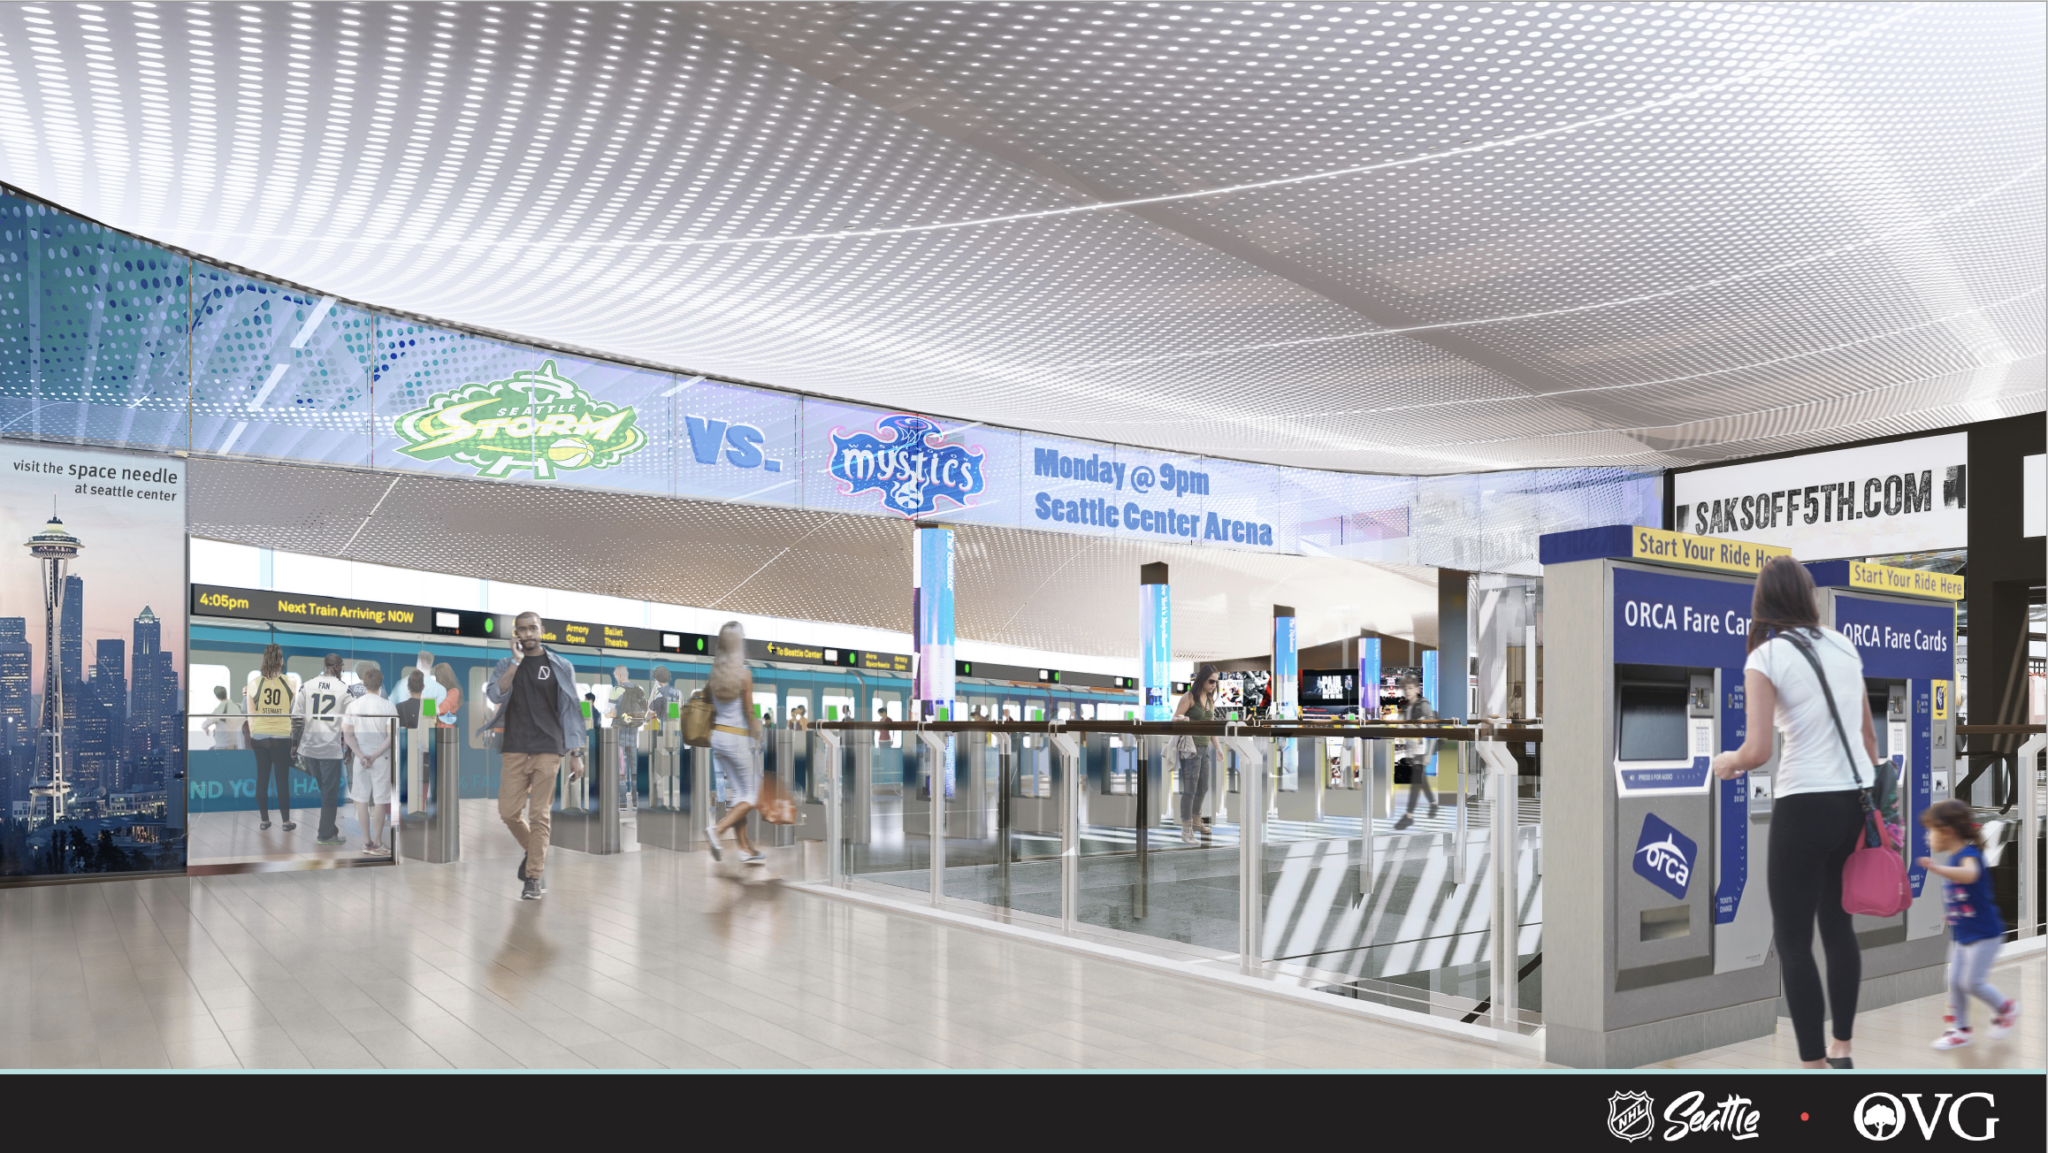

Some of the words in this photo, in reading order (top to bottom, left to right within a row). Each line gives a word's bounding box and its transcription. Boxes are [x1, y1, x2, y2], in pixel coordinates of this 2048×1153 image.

[408, 398, 642, 452] STORM
[496, 403, 577, 417] SEATTLE
[684, 415, 784, 473] VS.
[14, 460, 40, 473] visit
[43, 461, 64, 475] the
[68, 463, 117, 480] space
[122, 467, 178, 484] needle
[1034, 447, 1126, 491] Monday
[1130, 465, 1155, 493] @
[1159, 462, 1210, 498] 9pm
[75, 483, 87, 494] at
[90, 484, 134, 498] seattle
[137, 489, 177, 501] center
[1695, 470, 1932, 535] SAKSOFF5TH.COM
[1034, 492, 1120, 528] Seattle
[1123, 502, 1200, 539] Center
[1203, 511, 1274, 547] Arena
[1640, 532, 1678, 557] Start
[1682, 538, 1715, 562] Your
[1720, 544, 1751, 566] Ride
[1756, 549, 1775, 568] He
[1855, 564, 1883, 585] Start
[1887, 569, 1911, 588] Your
[1915, 573, 1937, 592] Ride
[1940, 577, 1962, 596] Here
[200, 593, 249, 610] 4:05pm
[278, 600, 307, 615] Next
[308, 603, 338, 617] Train
[340, 606, 386, 623] Arriving:
[388, 610, 414, 623] NOW
[1625, 600, 1677, 631] ORCA
[1684, 606, 1720, 633] Fare
[1725, 610, 1753, 636] Car
[1843, 623, 1880, 648] ORCA
[1885, 626, 1911, 649] Fare
[1914, 629, 1947, 652] Cards
[264, 688, 281, 706] 30
[318, 682, 330, 690] FAN
[311, 692, 336, 722] 12
[472, 773, 501, 789] FAS
[1646, 847, 1689, 887] orca
